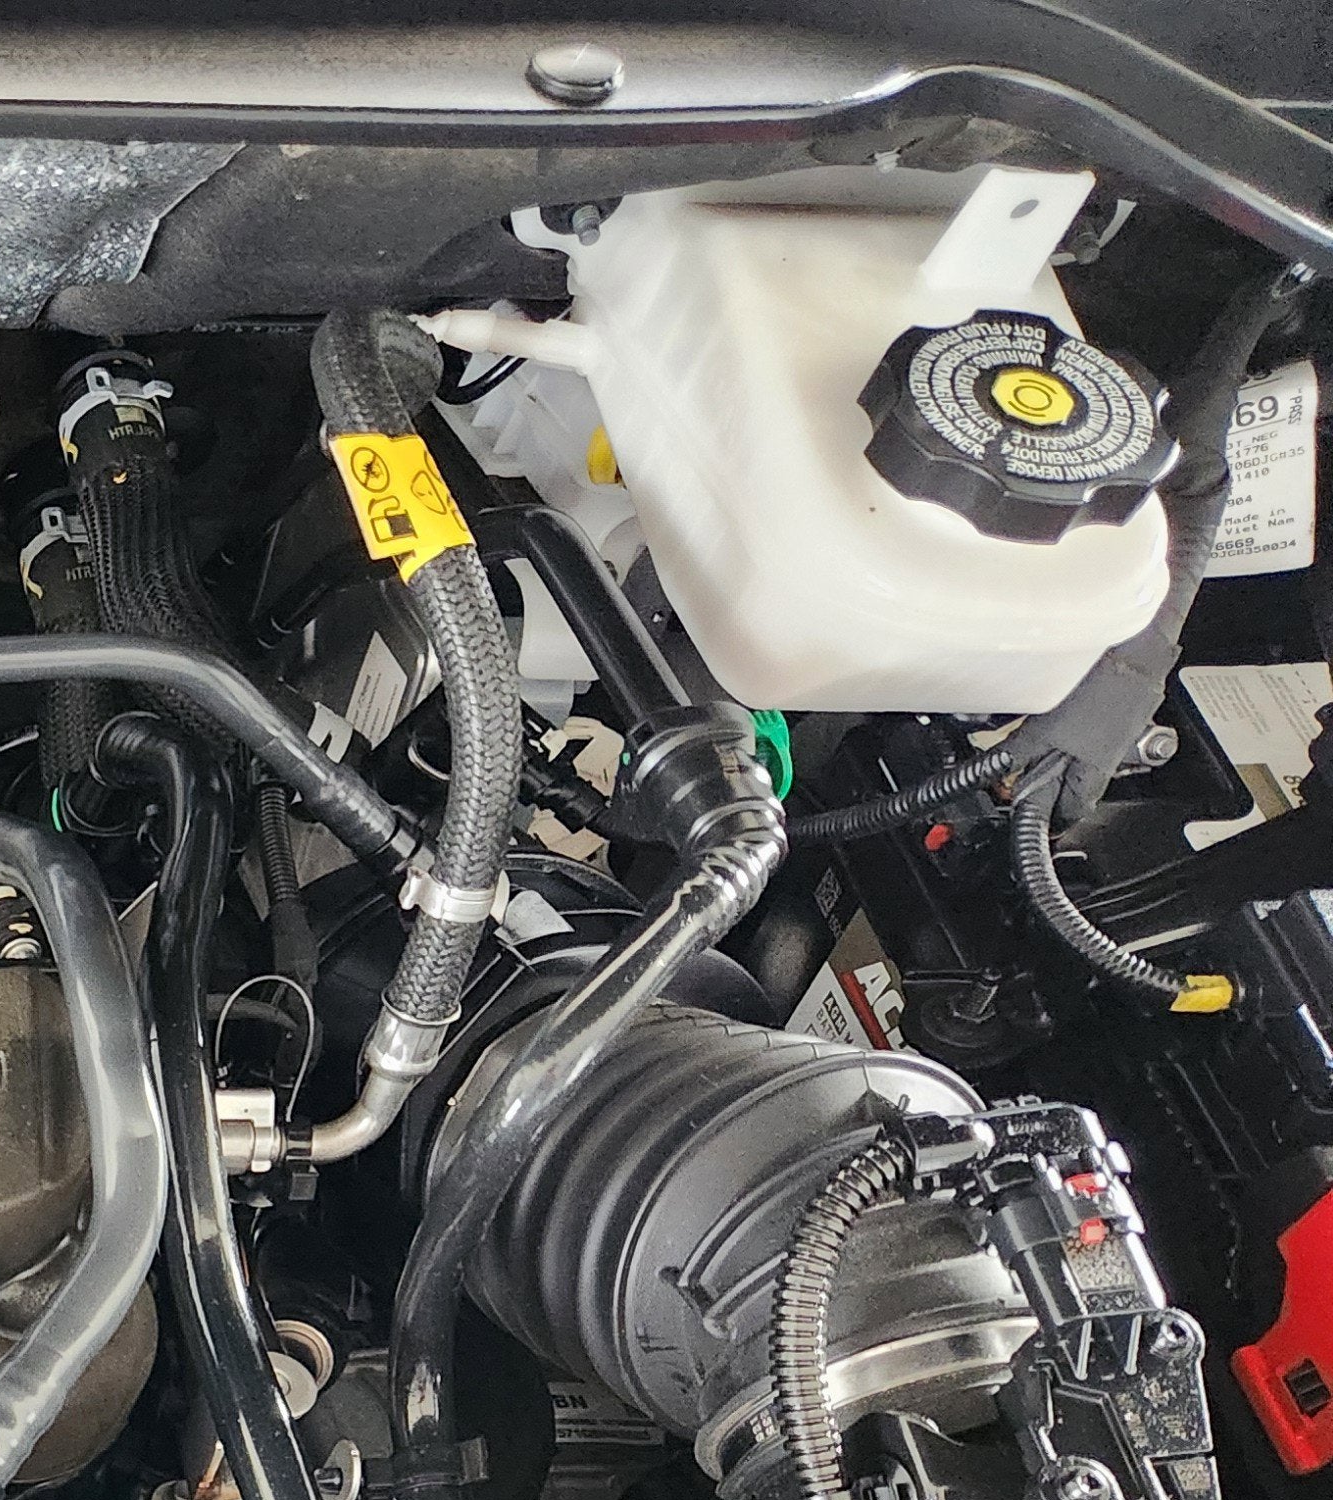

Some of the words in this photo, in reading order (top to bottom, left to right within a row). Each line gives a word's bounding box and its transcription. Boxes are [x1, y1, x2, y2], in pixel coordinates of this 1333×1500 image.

[954, 321, 1002, 340] FLUID
[998, 322, 1014, 335] 4
[1010, 322, 1046, 340] DOT
[921, 329, 963, 356] FROM
[954, 336, 1012, 357] BEFORE
[1009, 336, 1045, 354] CAP
[909, 357, 934, 397] SEALED
[935, 398, 966, 419] USE
[958, 399, 1005, 435] FILLER
[952, 417, 995, 446] ONLY
[996, 439, 1015, 456] 4
[1010, 444, 1040, 463] DOT
[1041, 449, 1083, 465] FREIN
[1074, 445, 1100, 462] DE
[1061, 461, 1111, 480] AVANT
[1225, 514, 1259, 526] Made
[1270, 508, 1286, 517] in
[1225, 523, 1259, 536] Viet
[1268, 517, 1295, 528] Nam
[823, 995, 847, 1036] AGM
